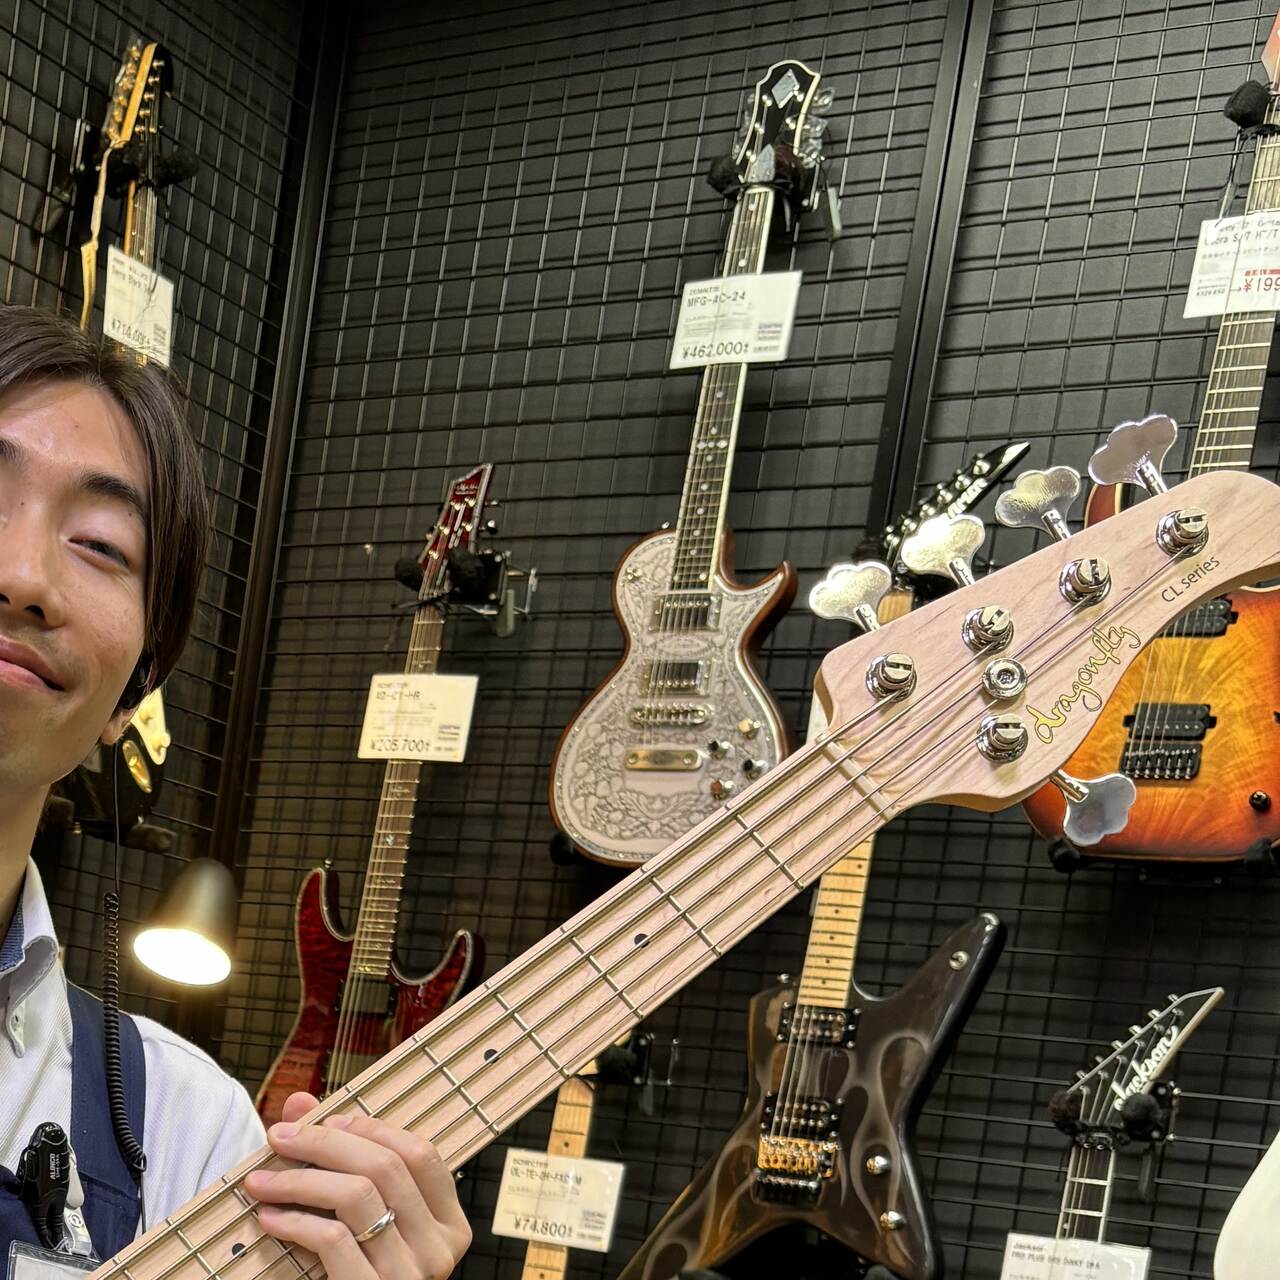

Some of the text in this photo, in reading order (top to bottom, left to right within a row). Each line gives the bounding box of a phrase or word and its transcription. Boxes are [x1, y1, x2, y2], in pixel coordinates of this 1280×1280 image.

[1161, 556, 1220, 603] CL series
[1026, 625, 1141, 744] dragonfly
